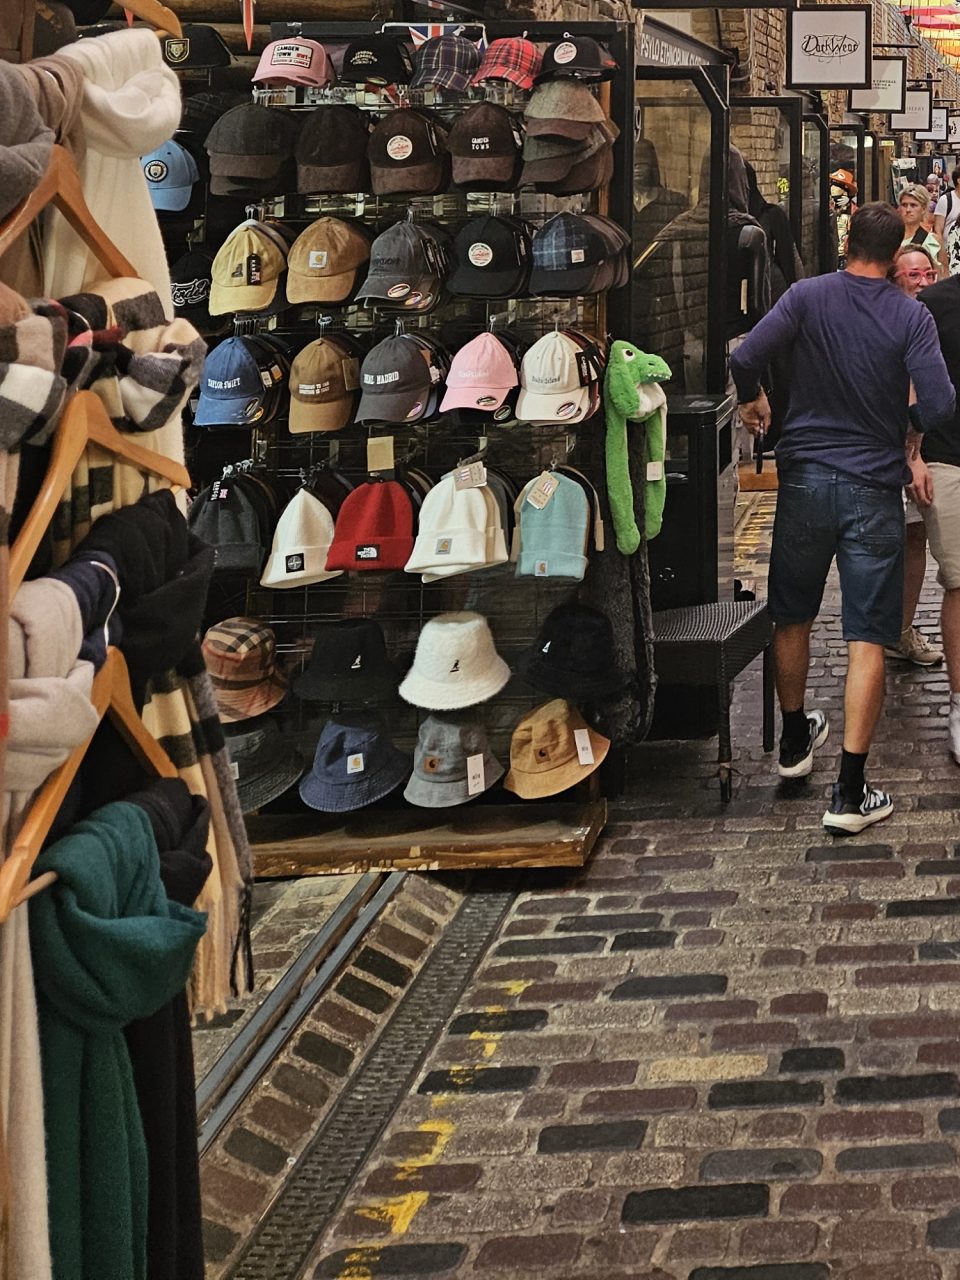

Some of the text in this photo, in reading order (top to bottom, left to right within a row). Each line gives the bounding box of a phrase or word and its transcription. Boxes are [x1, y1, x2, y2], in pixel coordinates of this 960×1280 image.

[640, 32, 660, 62] PSYLO
[207, 377, 241, 389] TAYLOR SWIFT
[376, 371, 400, 385] MADRID
